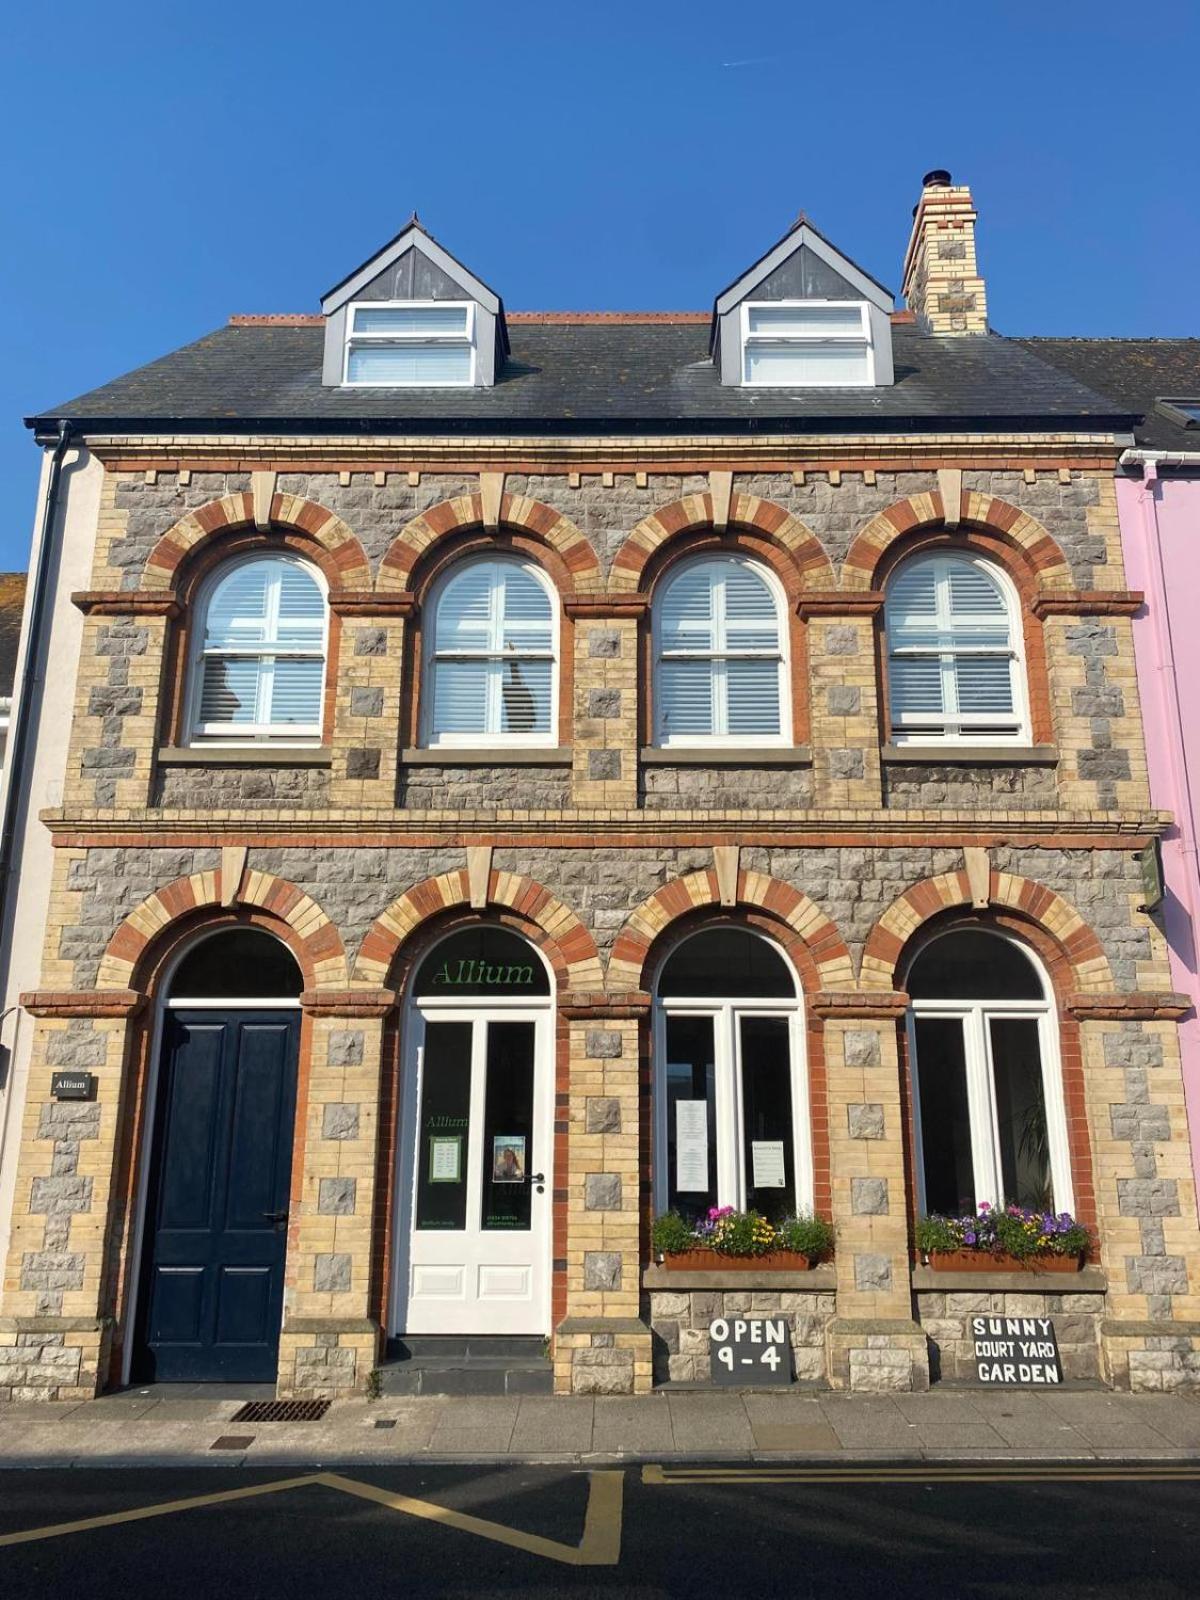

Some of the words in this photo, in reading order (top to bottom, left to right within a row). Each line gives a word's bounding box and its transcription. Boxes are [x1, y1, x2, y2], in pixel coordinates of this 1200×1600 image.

[432, 960, 533, 984] Allium
[55, 1080, 85, 1089] Allium
[427, 1116, 468, 1127] Allium
[710, 1319, 785, 1343] OPEN
[973, 1318, 1051, 1336] SUNNY
[975, 1341, 1015, 1358] COURT
[1019, 1341, 1056, 1358] YARD
[978, 1362, 1059, 1383] GARDEN
